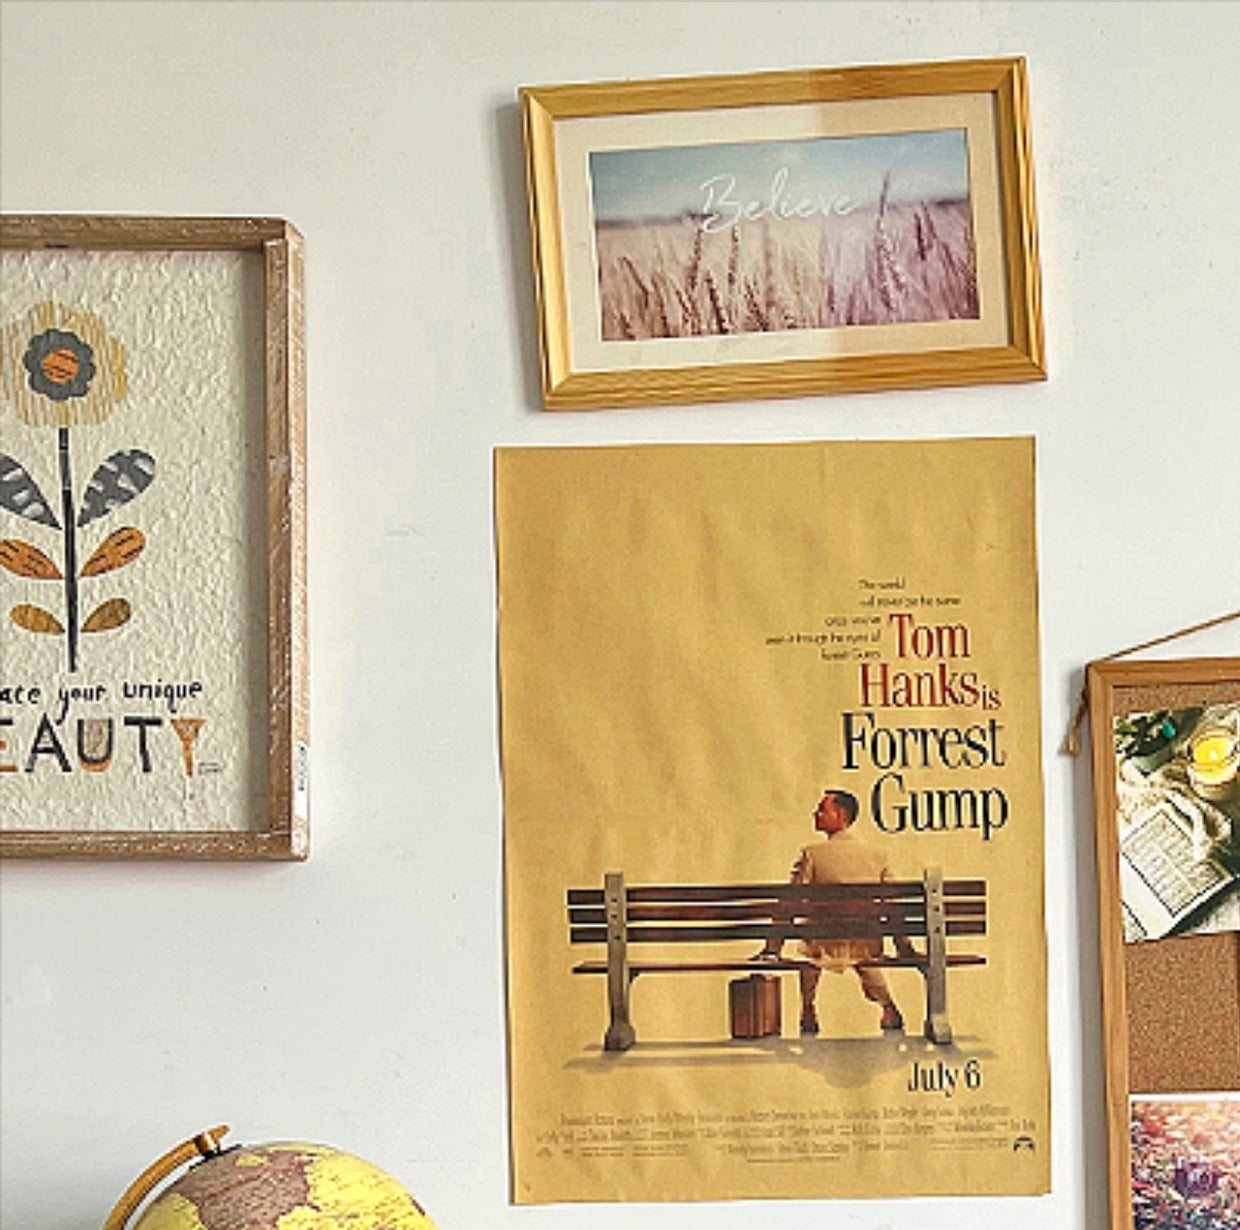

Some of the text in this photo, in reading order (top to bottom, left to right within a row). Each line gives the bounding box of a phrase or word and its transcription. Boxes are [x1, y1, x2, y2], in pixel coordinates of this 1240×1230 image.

[700, 168, 861, 232] Believe
[889, 613, 970, 658] Tom
[56, 686, 106, 725] your
[123, 678, 203, 713] unique
[860, 663, 1001, 710] Hanks is
[841, 712, 1006, 769] Forrest
[871, 772, 1008, 840] Gump
[908, 1060, 981, 1097] July 6
